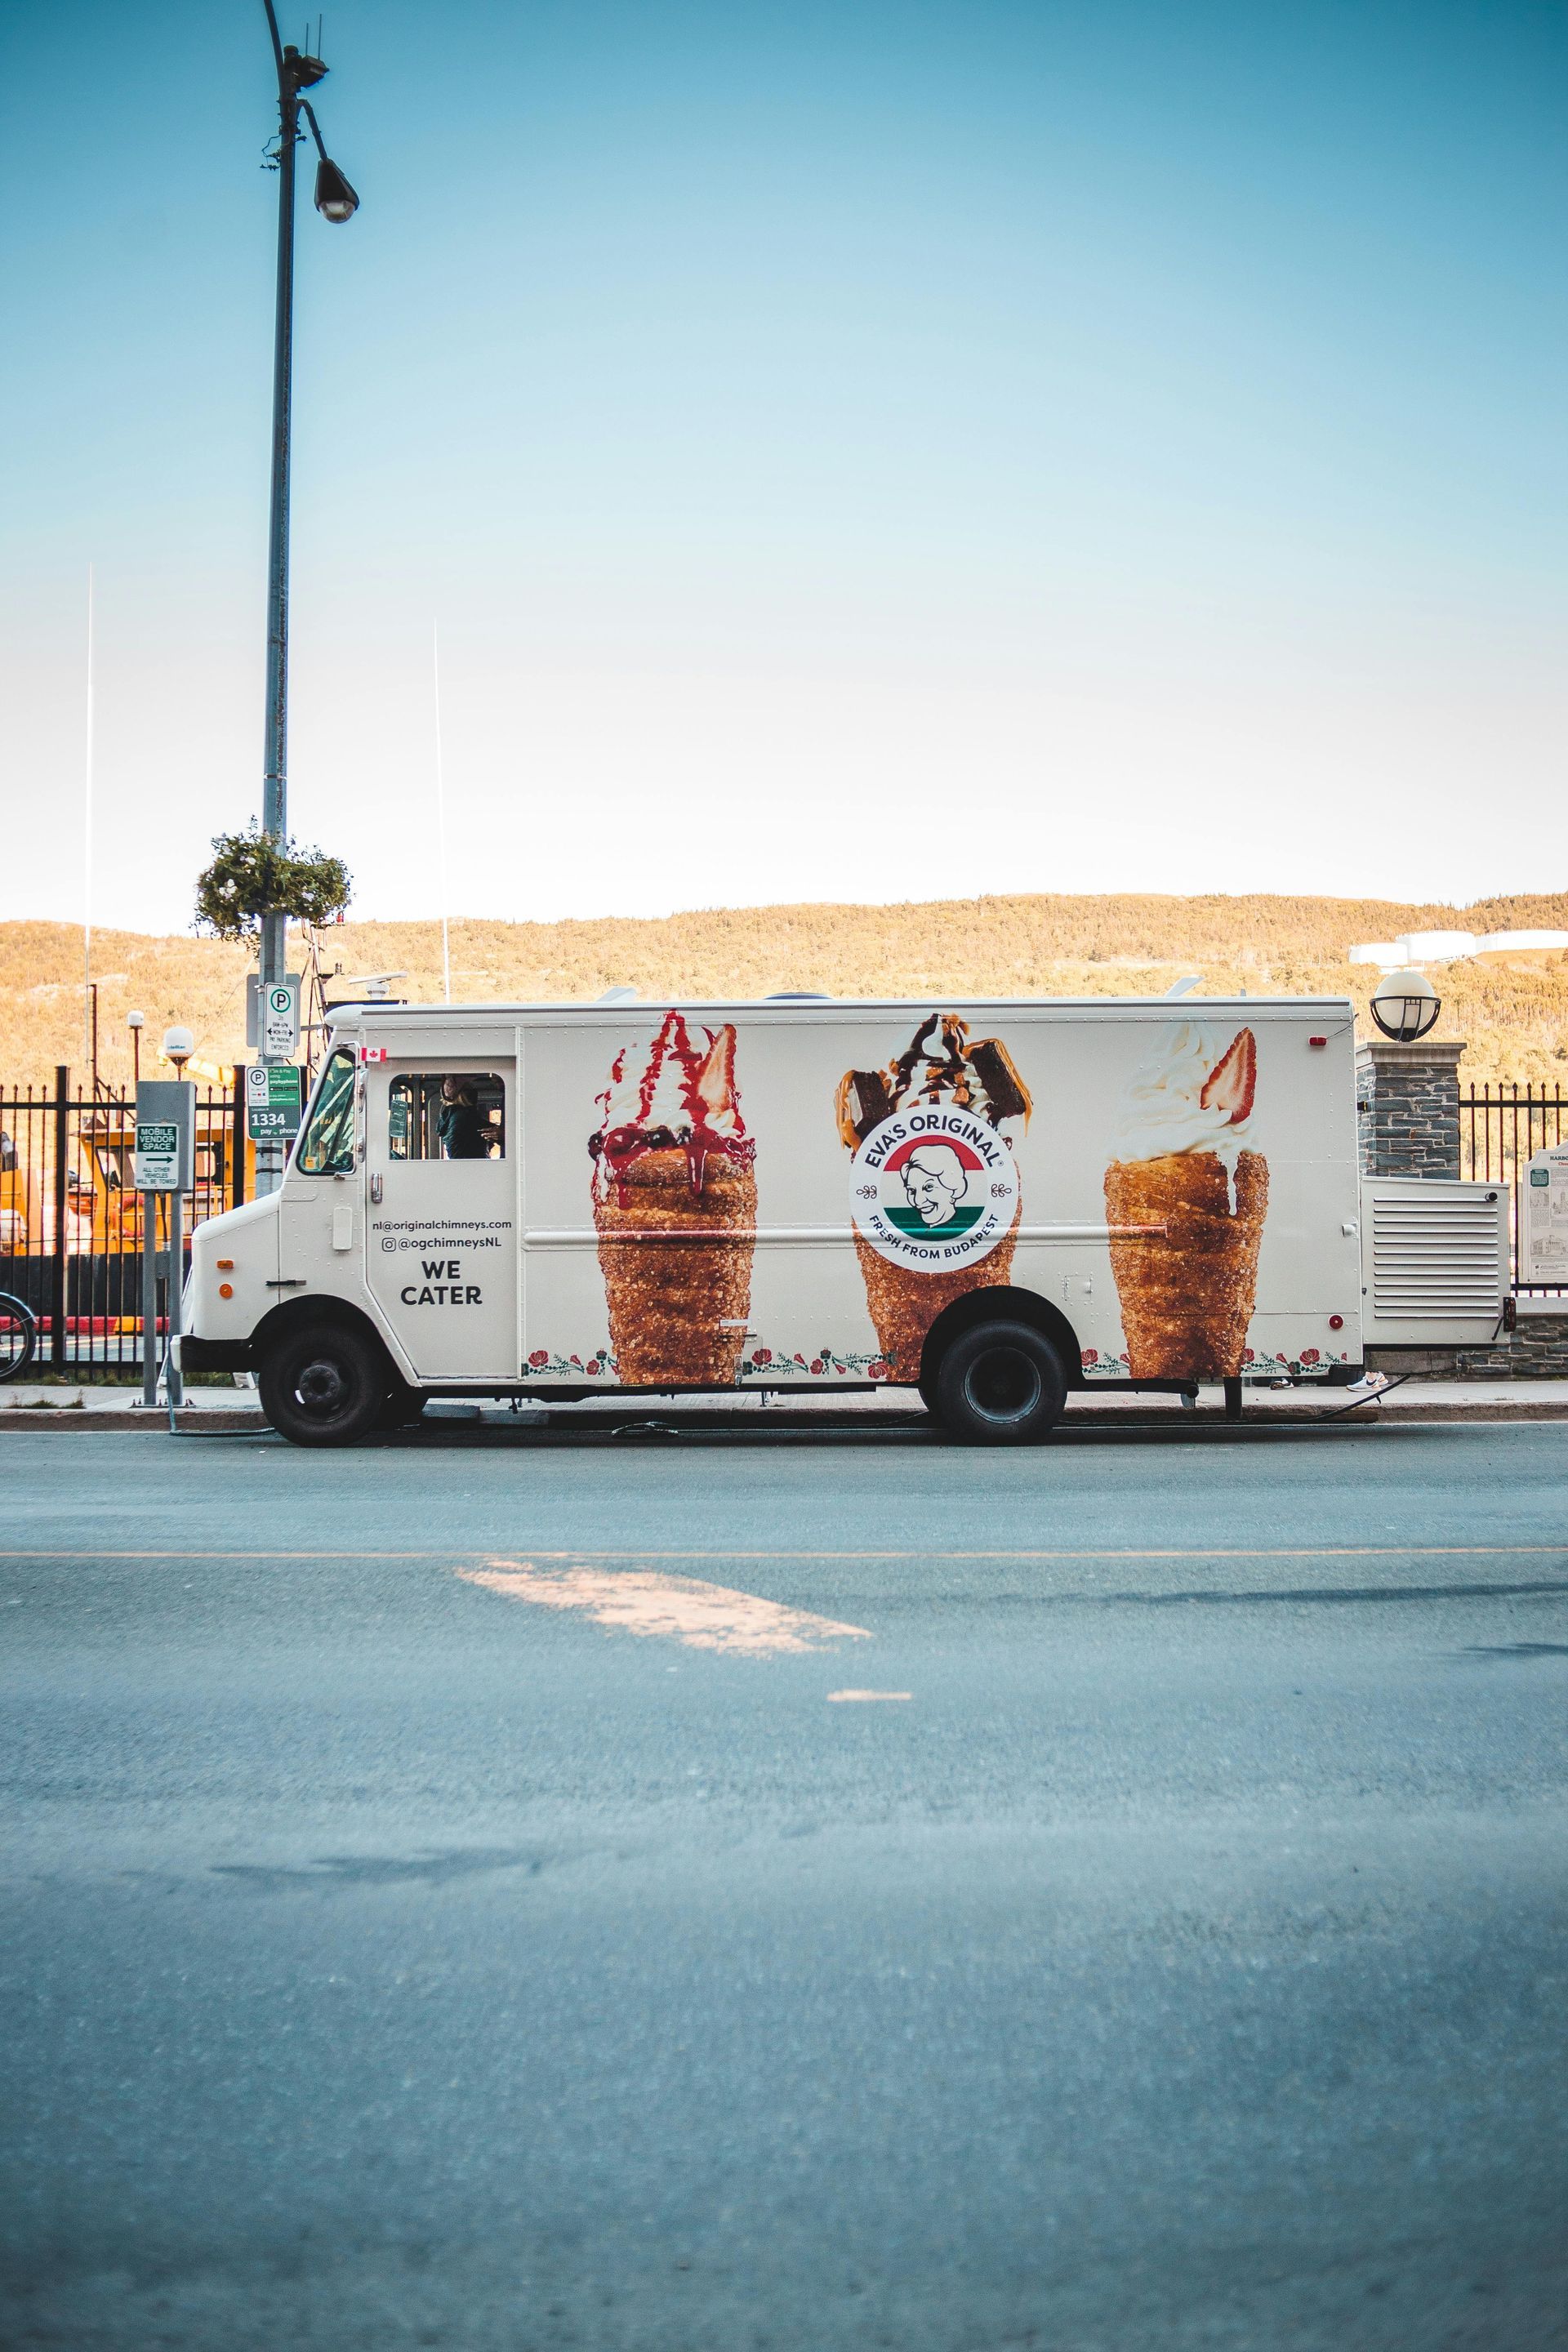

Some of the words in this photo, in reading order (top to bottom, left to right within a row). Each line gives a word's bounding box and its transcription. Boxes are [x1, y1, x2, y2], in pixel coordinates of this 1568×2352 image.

[277, 994, 286, 1007] P
[252, 1113, 286, 1126] 1334
[864, 1123, 907, 1169] EVA'S
[909, 1114, 1000, 1168] ORIGINAL
[372, 1220, 512, 1232] nl@originalchimneys.com
[399, 1237, 502, 1251] @ogchimneysNL
[869, 1214, 902, 1248] FRESH
[902, 1245, 940, 1259] FROM
[945, 1214, 998, 1258] BUDAPEST
[421, 1260, 461, 1280] WE
[400, 1285, 483, 1306] CATER
